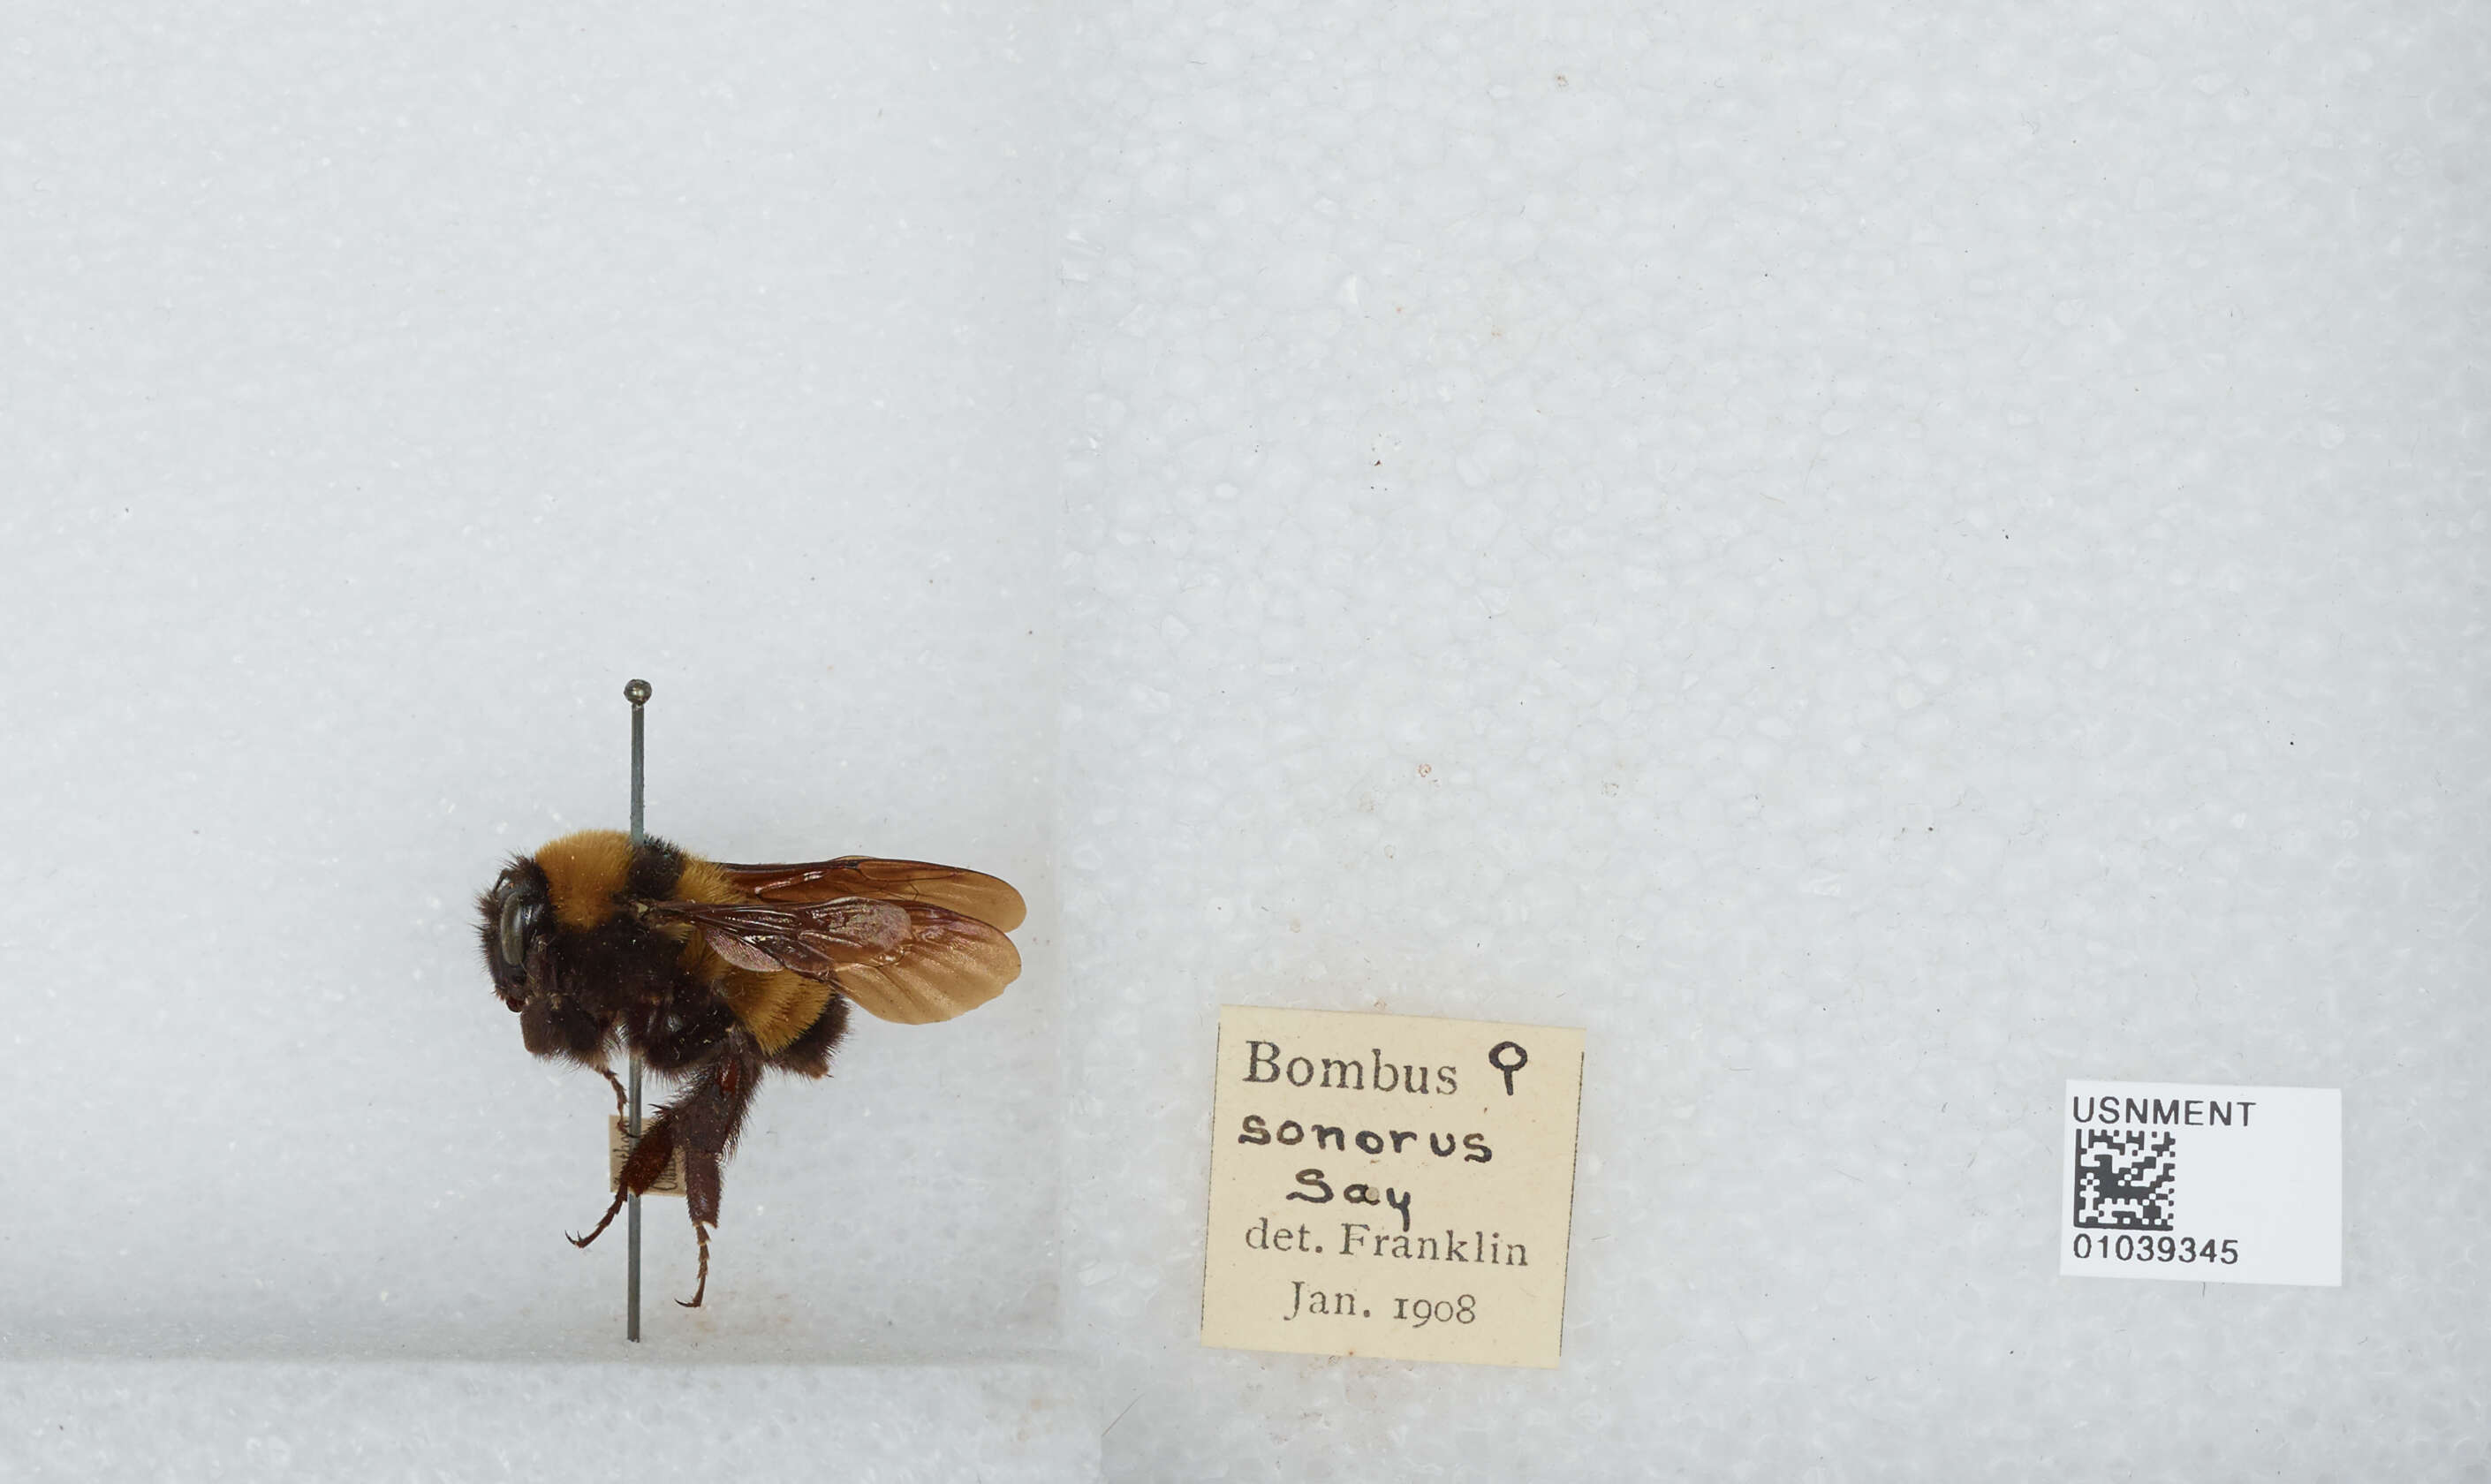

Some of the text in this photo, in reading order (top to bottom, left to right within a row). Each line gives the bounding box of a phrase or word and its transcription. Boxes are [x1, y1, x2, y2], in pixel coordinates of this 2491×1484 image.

[1242, 1040, 1458, 1095] Bombus
[2073, 1096, 2256, 1126] USNMENT
[1238, 1115, 1493, 1163] sonorus
[1285, 1168, 1412, 1232] Say
[1245, 1216, 1529, 1267] det. Franklin
[2073, 1233, 2238, 1265] 01039345
[1283, 1280, 1477, 1329] Jan. 1908
